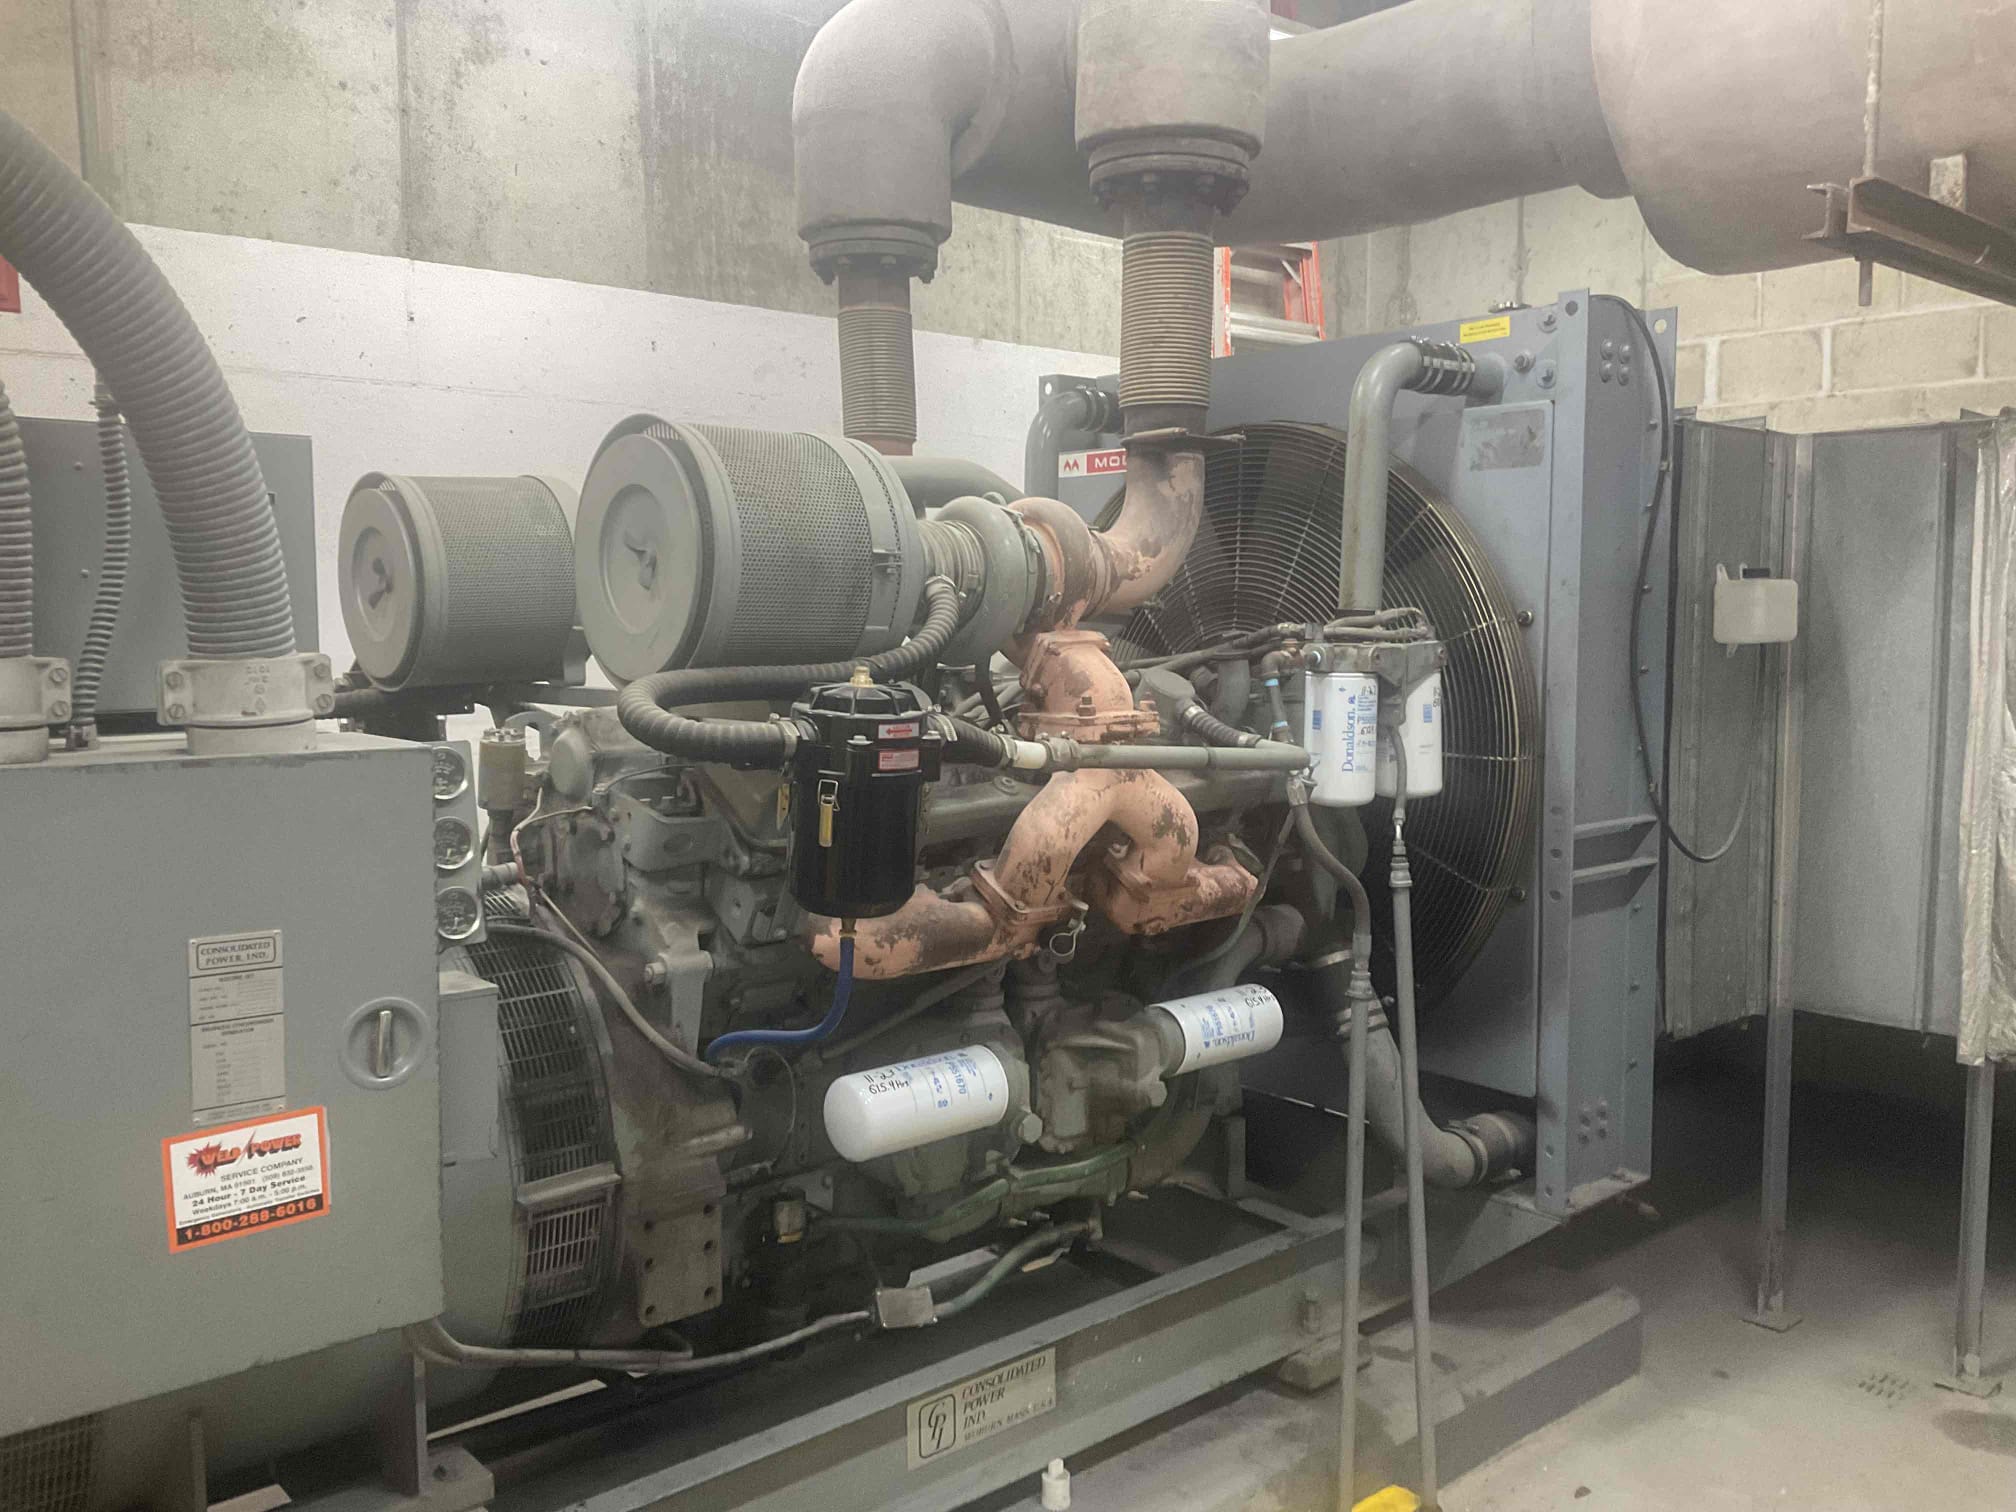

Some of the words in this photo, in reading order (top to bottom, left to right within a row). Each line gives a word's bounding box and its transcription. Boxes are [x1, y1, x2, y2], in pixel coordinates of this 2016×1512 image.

[200, 941, 270, 956] CONSOLIDATED
[199, 1146, 241, 1168] WELD
[248, 1134, 302, 1158] POWER
[220, 1168, 259, 1182] SERVICE
[260, 1157, 303, 1173] COMPANY
[192, 1198, 205, 1207] 24
[207, 1193, 231, 1204] Hour
[249, 1185, 268, 1195] Day
[270, 1175, 306, 1189] Service
[220, 1183, 233, 1191] MA
[192, 1201, 232, 1216] Weekdays
[961, 1356, 1046, 1400] CONSOLIDATED
[963, 1387, 1006, 1414] POWER
